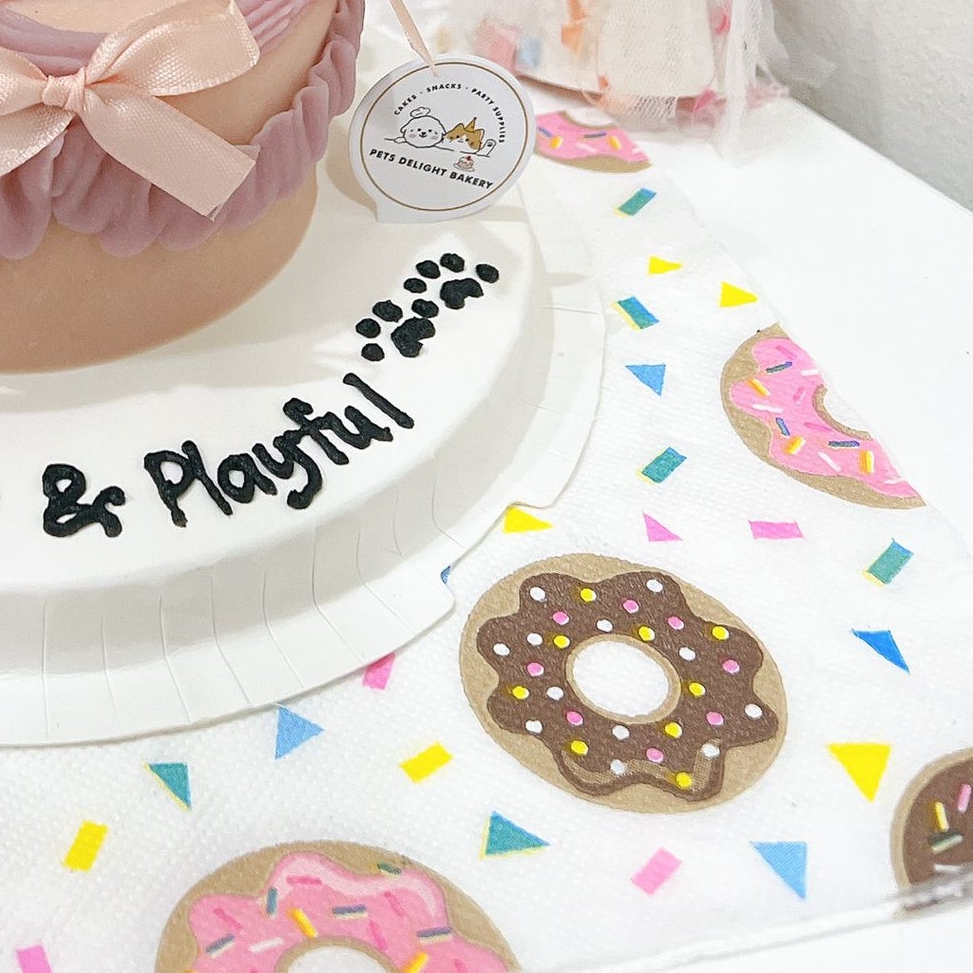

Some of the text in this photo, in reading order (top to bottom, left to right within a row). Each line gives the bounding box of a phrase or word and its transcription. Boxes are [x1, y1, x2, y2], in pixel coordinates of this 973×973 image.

[394, 83, 506, 143] CAKES SNACKS PARTY SUPPLIES
[369, 148, 493, 189] PETS DELIGHT BAKERY
[41, 463, 125, 538] &
[143, 372, 416, 529] Playful
